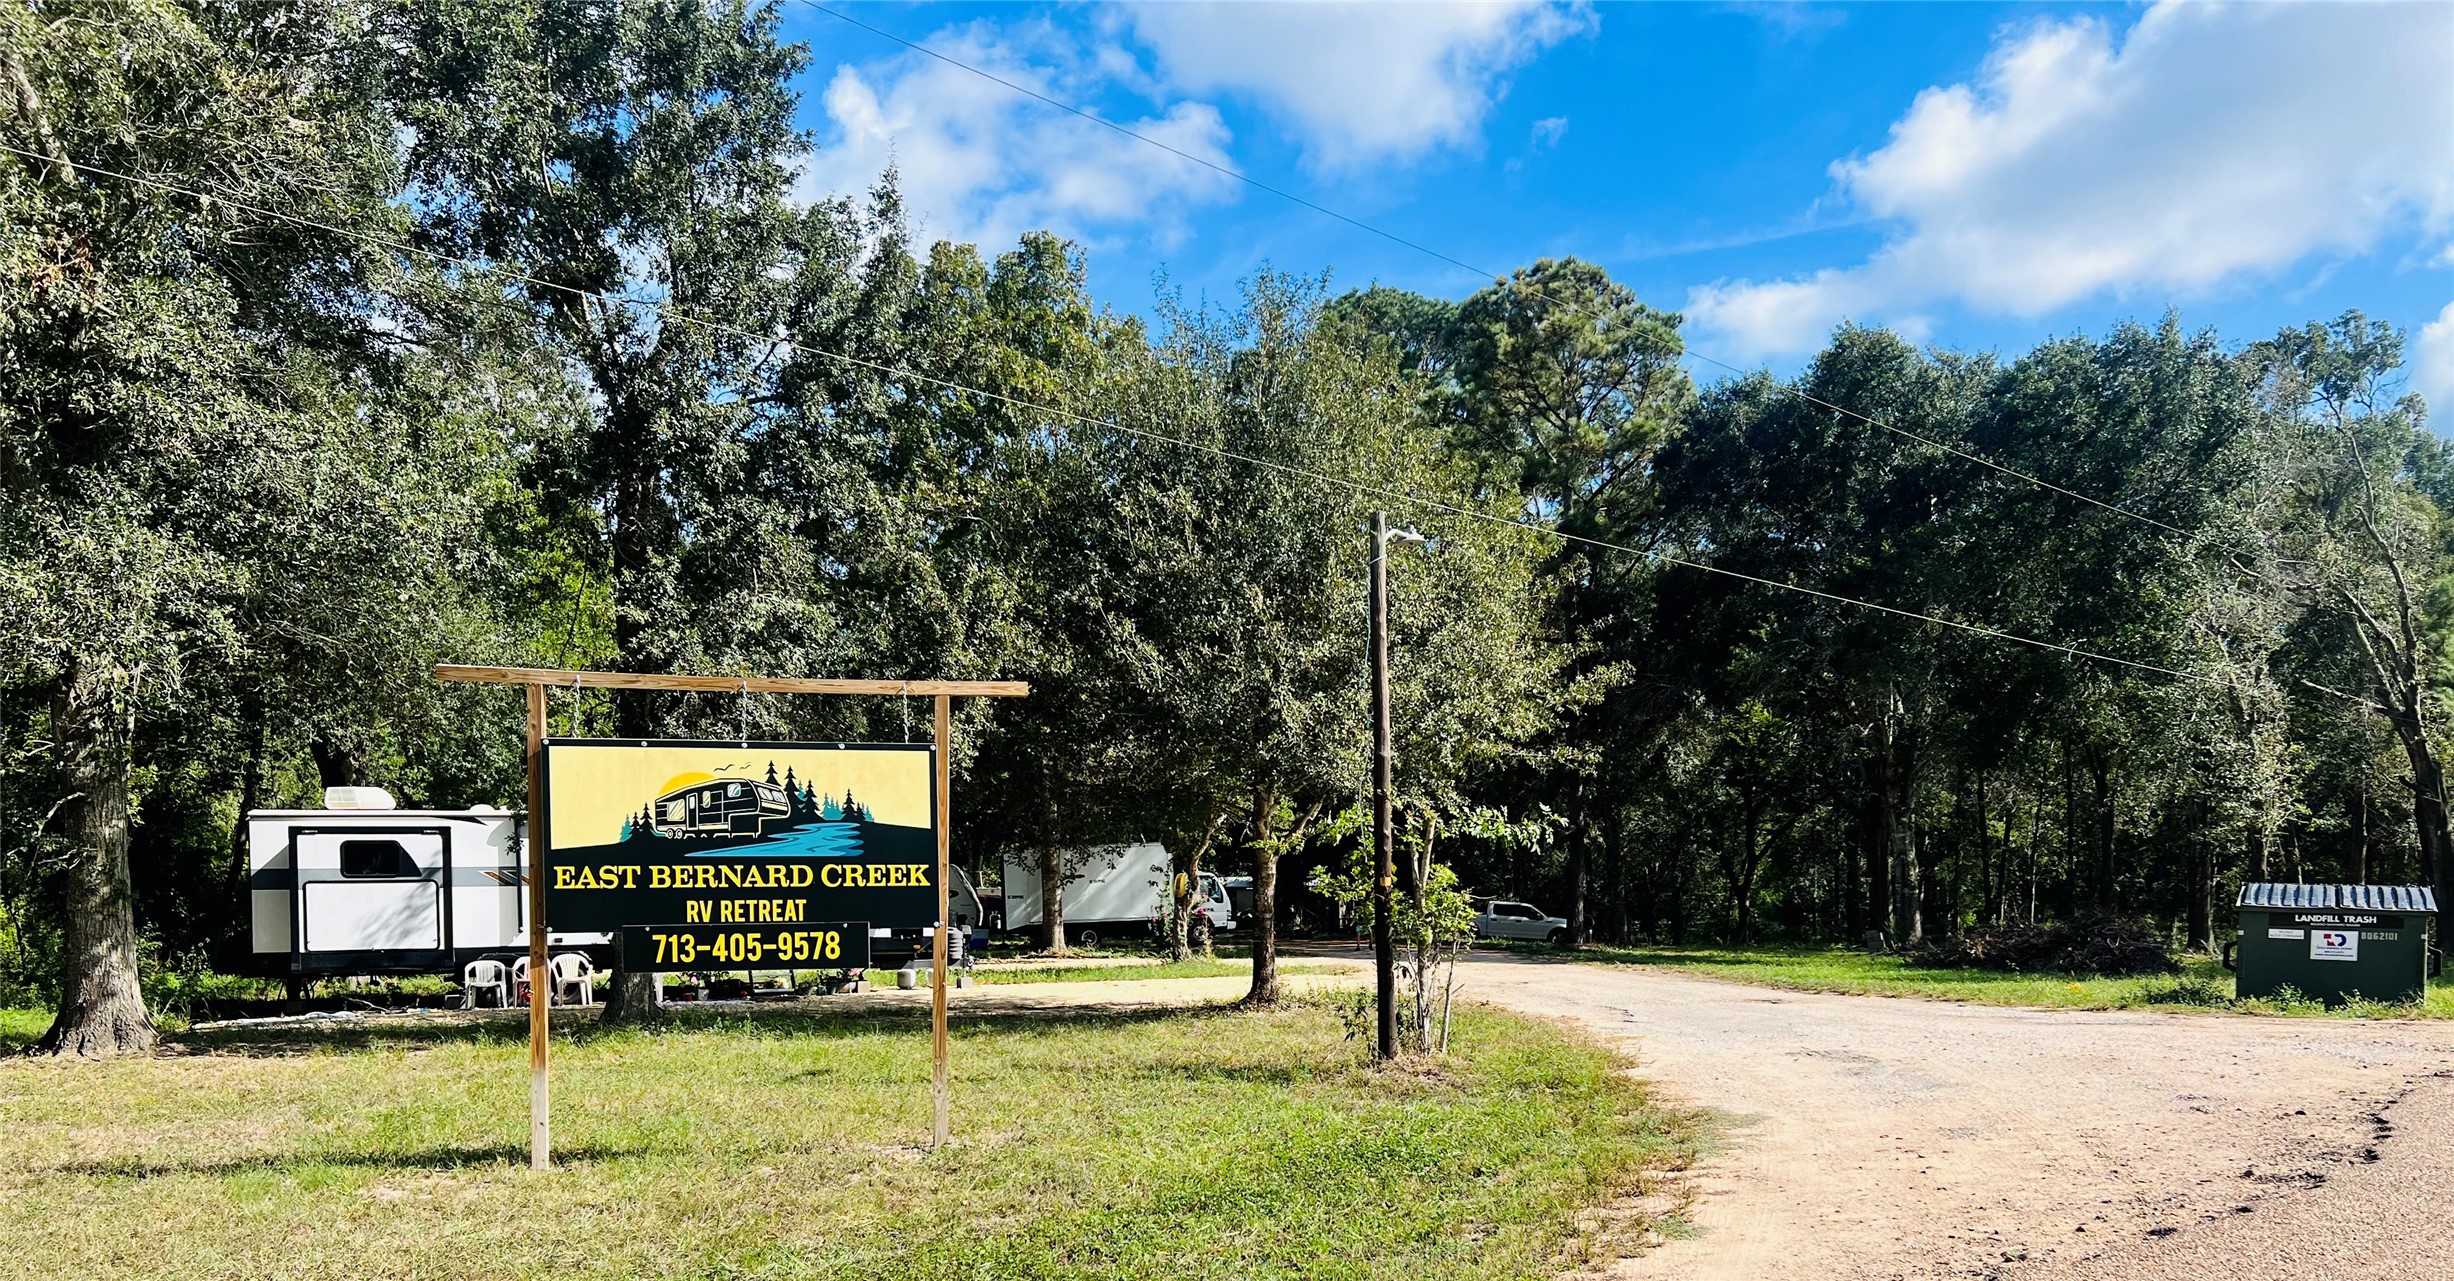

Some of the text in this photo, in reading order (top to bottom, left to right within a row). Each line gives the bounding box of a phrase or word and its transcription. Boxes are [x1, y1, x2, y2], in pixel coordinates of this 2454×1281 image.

[553, 864, 931, 889] EAST BERNARD CREEK
[686, 899, 807, 923] RV RETREAT
[2295, 914, 2377, 924] LANDFILL TRASH
[652, 930, 841, 963] 713-405-9578
